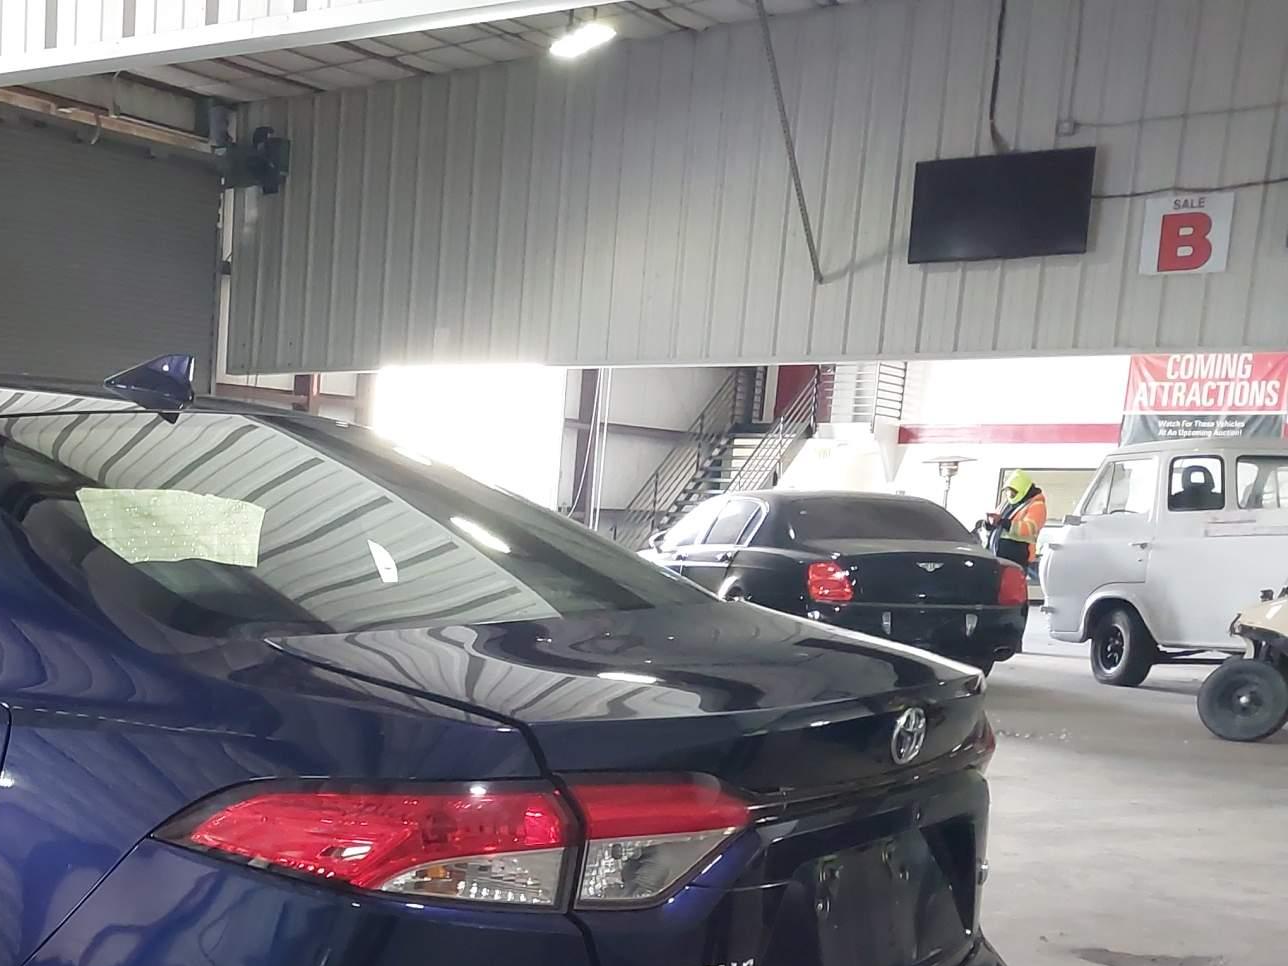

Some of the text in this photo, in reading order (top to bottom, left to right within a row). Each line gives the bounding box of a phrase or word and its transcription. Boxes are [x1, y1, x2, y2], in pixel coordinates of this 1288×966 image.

[1173, 197, 1206, 210] SALE
[1157, 212, 1212, 272] B
[1166, 353, 1254, 379] COMING
[1133, 380, 1281, 408] ATTRACTIONS
